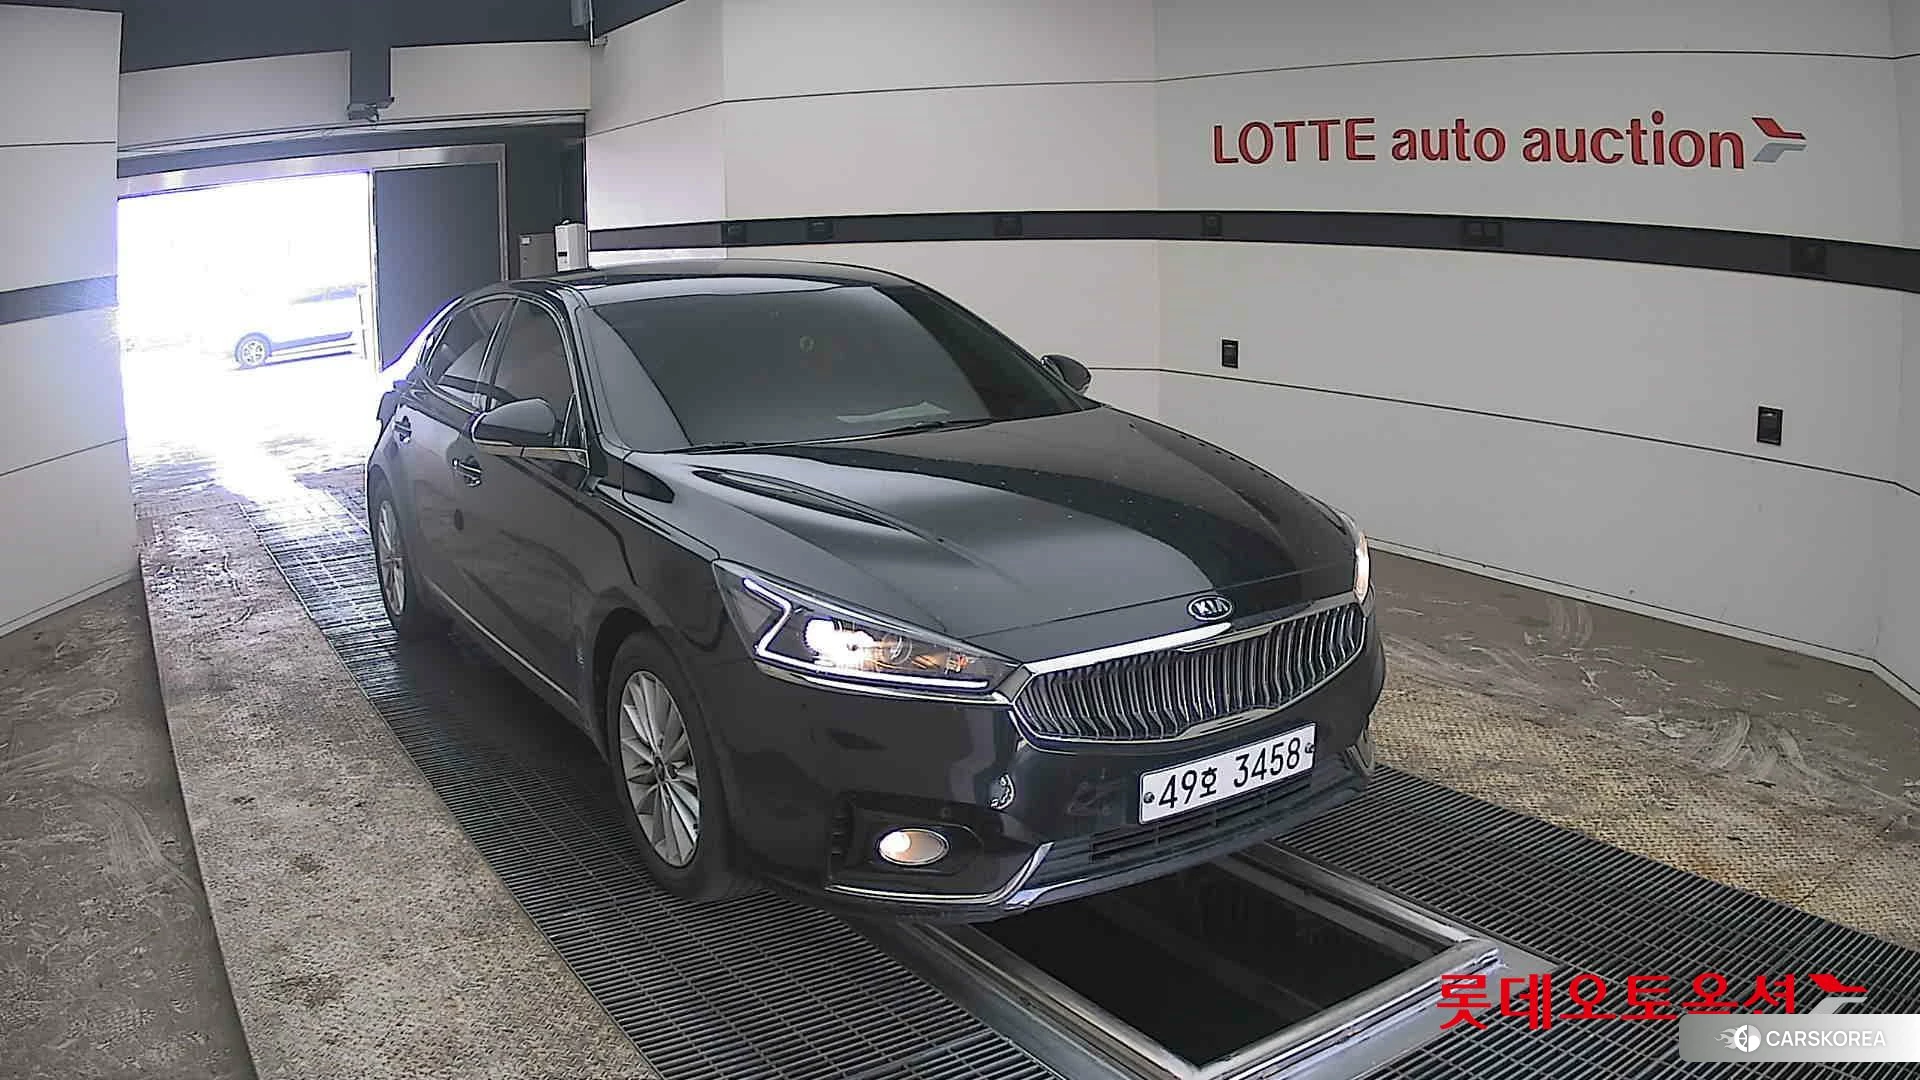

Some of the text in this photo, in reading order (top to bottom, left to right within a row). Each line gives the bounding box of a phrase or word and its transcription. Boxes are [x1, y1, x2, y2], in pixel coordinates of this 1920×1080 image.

[1213, 110, 1746, 170] LOTTE auto auction
[1194, 599, 1229, 616] KIA
[1158, 737, 1301, 809] 49호 3458
